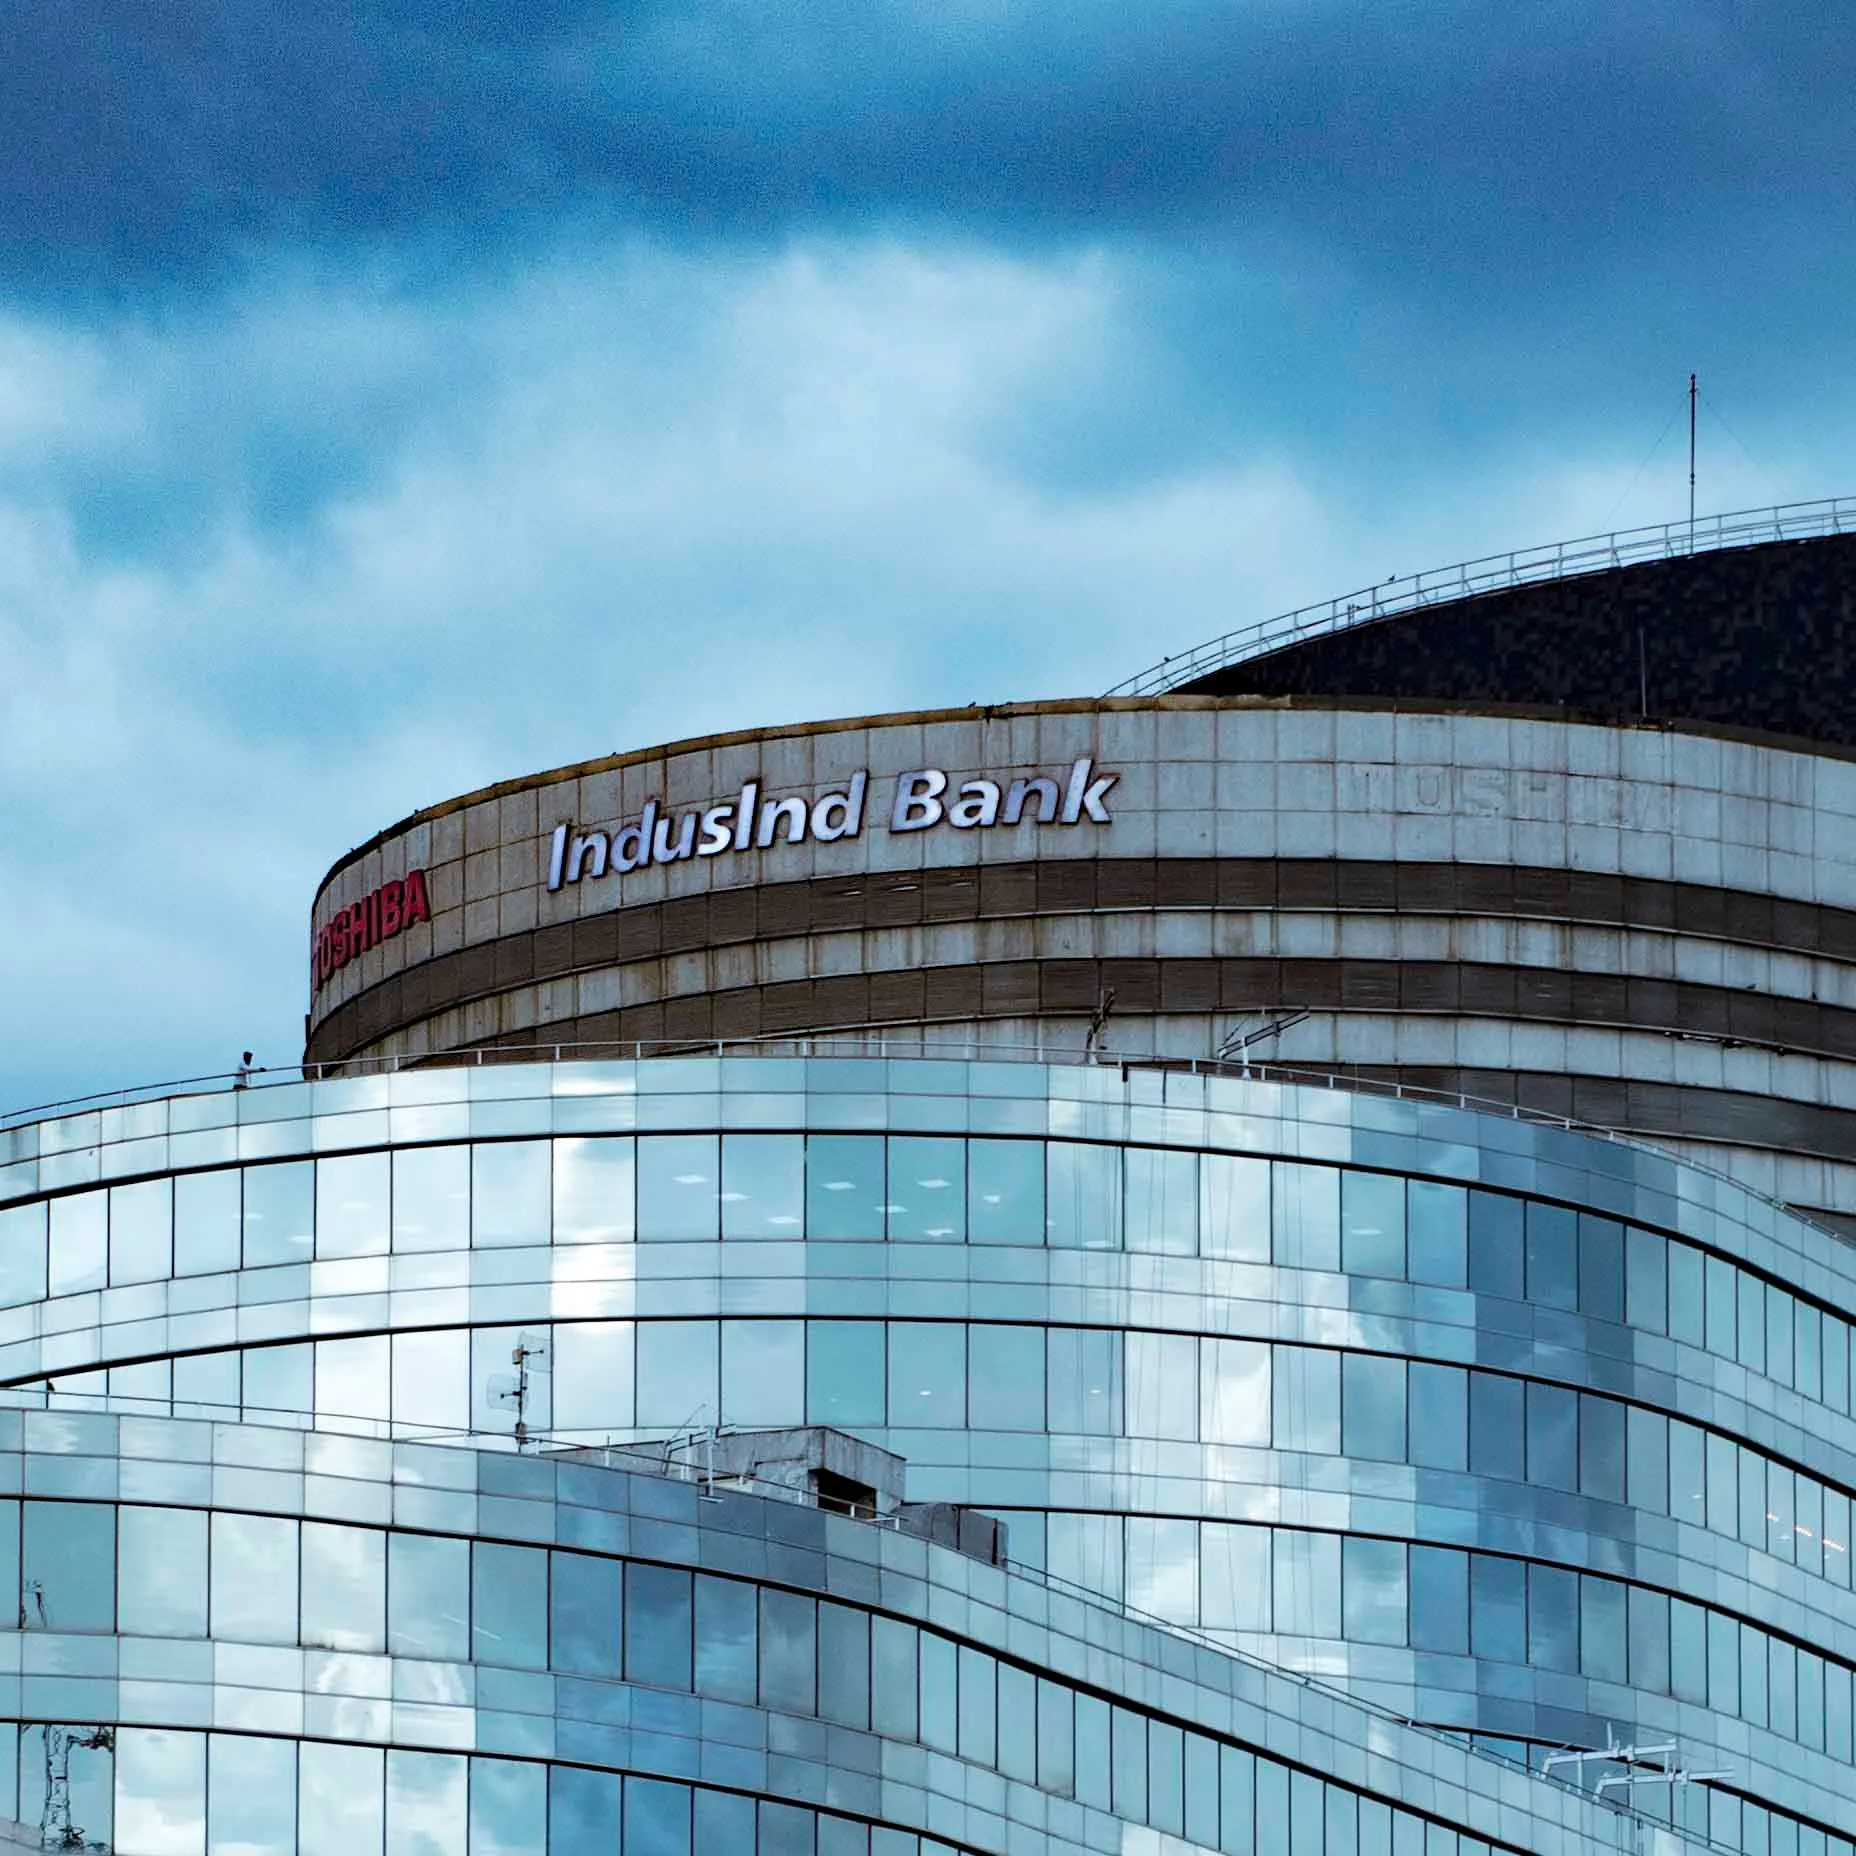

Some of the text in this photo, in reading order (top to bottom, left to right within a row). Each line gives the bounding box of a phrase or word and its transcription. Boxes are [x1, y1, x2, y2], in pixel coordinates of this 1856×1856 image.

[546, 757, 1120, 892] IndusInd Bank
[312, 869, 432, 993] TOSHIBA
